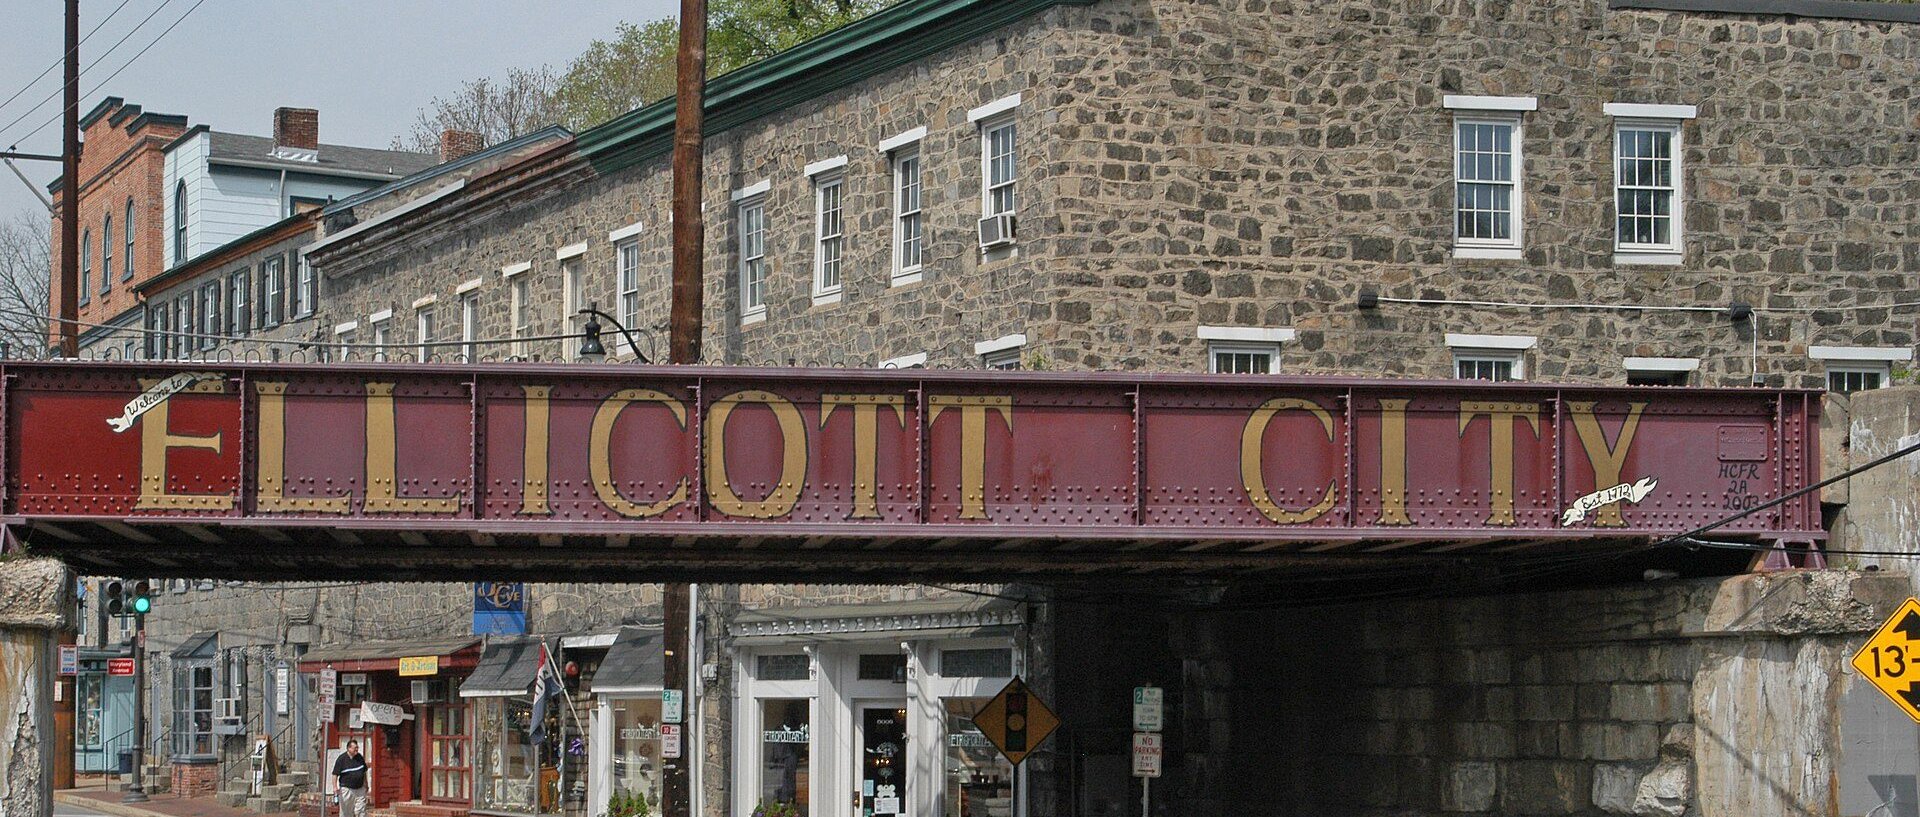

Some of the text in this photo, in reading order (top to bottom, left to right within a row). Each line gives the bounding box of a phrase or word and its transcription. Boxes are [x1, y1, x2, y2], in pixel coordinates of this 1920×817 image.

[126, 377, 183, 416] Welcome to
[131, 378, 1649, 528] ELLICOTT CITY
[1718, 463, 1760, 480] HCFR
[1607, 484, 1631, 501] 1772
[1728, 480, 1747, 494] 2A
[663, 691, 670, 701] 2
[1136, 691, 1142, 703] 2
[1142, 737, 1153, 746] NO
[1135, 746, 1162, 755] PARKING
